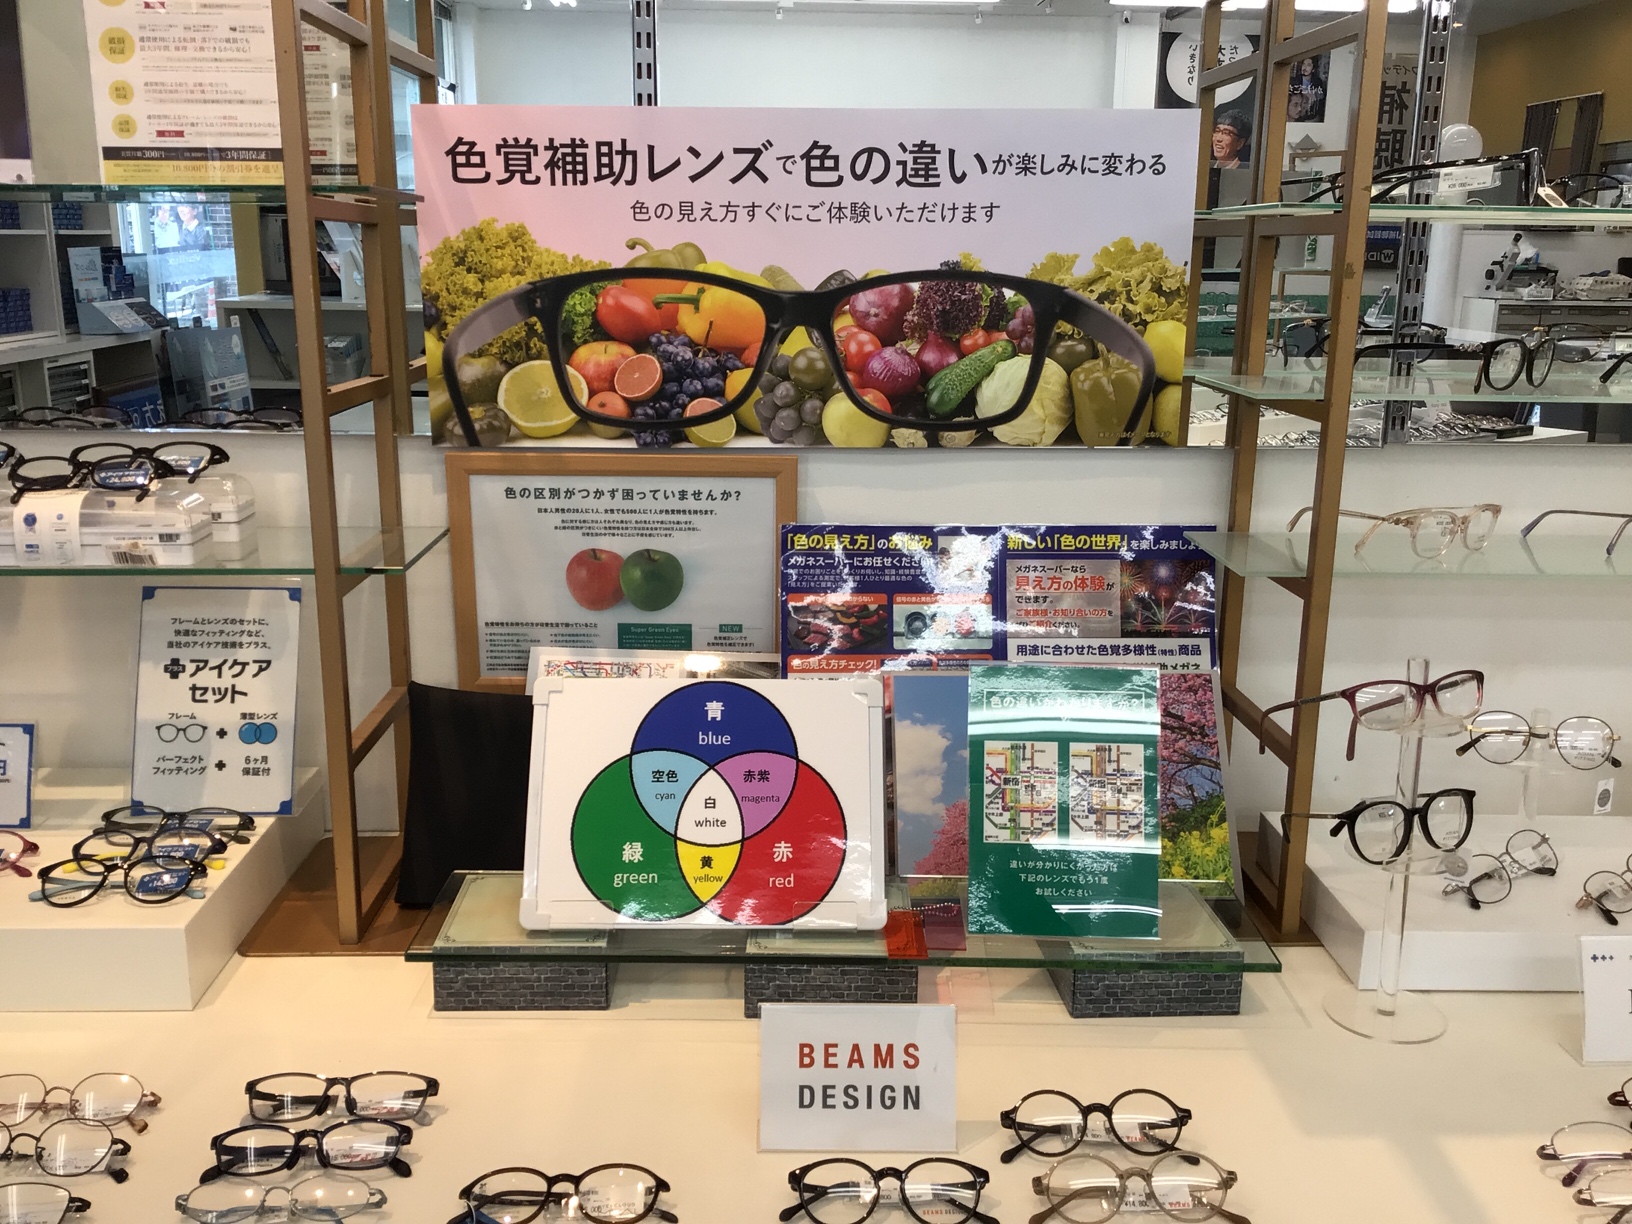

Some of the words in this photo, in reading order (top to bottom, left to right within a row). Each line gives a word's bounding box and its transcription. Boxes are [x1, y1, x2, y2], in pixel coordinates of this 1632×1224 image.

[444, 136, 1167, 187] 色覚補助レンズで色の違いが楽しみに変わる
[630, 200, 1001, 224] 色の見え方すぐにご体験いただけます
[504, 487, 741, 501] 色の区別がつかず困っていませんか?
[1007, 534, 1203, 550] 新しい「色の世界」を楽しみましょ
[1015, 565, 1086, 573] メガネスーパーなら
[1015, 575, 1115, 591] 見え方の体験が
[170, 617, 269, 626] フレームとレンズのセットに、
[174, 629, 265, 638] 快適なフィッティングなど、
[167, 641, 272, 650] 当社のアイケア技術をプラス。
[189, 659, 272, 679] アイケア
[189, 684, 248, 704] セット
[704, 701, 724, 721] 青
[699, 732, 731, 745] blue
[156, 756, 204, 764] パーフェクト
[152, 766, 207, 775] フィッティング
[242, 767, 271, 776] 保証付
[651, 769, 679, 783] 空色
[743, 769, 770, 783] 赤紫
[655, 791, 676, 801] cyan
[741, 793, 780, 804] magenta
[705, 797, 716, 809] 白
[694, 817, 727, 828] white
[622, 842, 644, 863] 緑
[699, 856, 713, 869] 黄
[773, 841, 793, 862] 赤
[613, 872, 658, 888] green
[693, 873, 723, 885] yellow
[769, 874, 794, 887] red
[1035, 887, 1092, 897] お試しください
[798, 1043, 920, 1069] BEAMS
[798, 1084, 921, 1110] DESIGN
